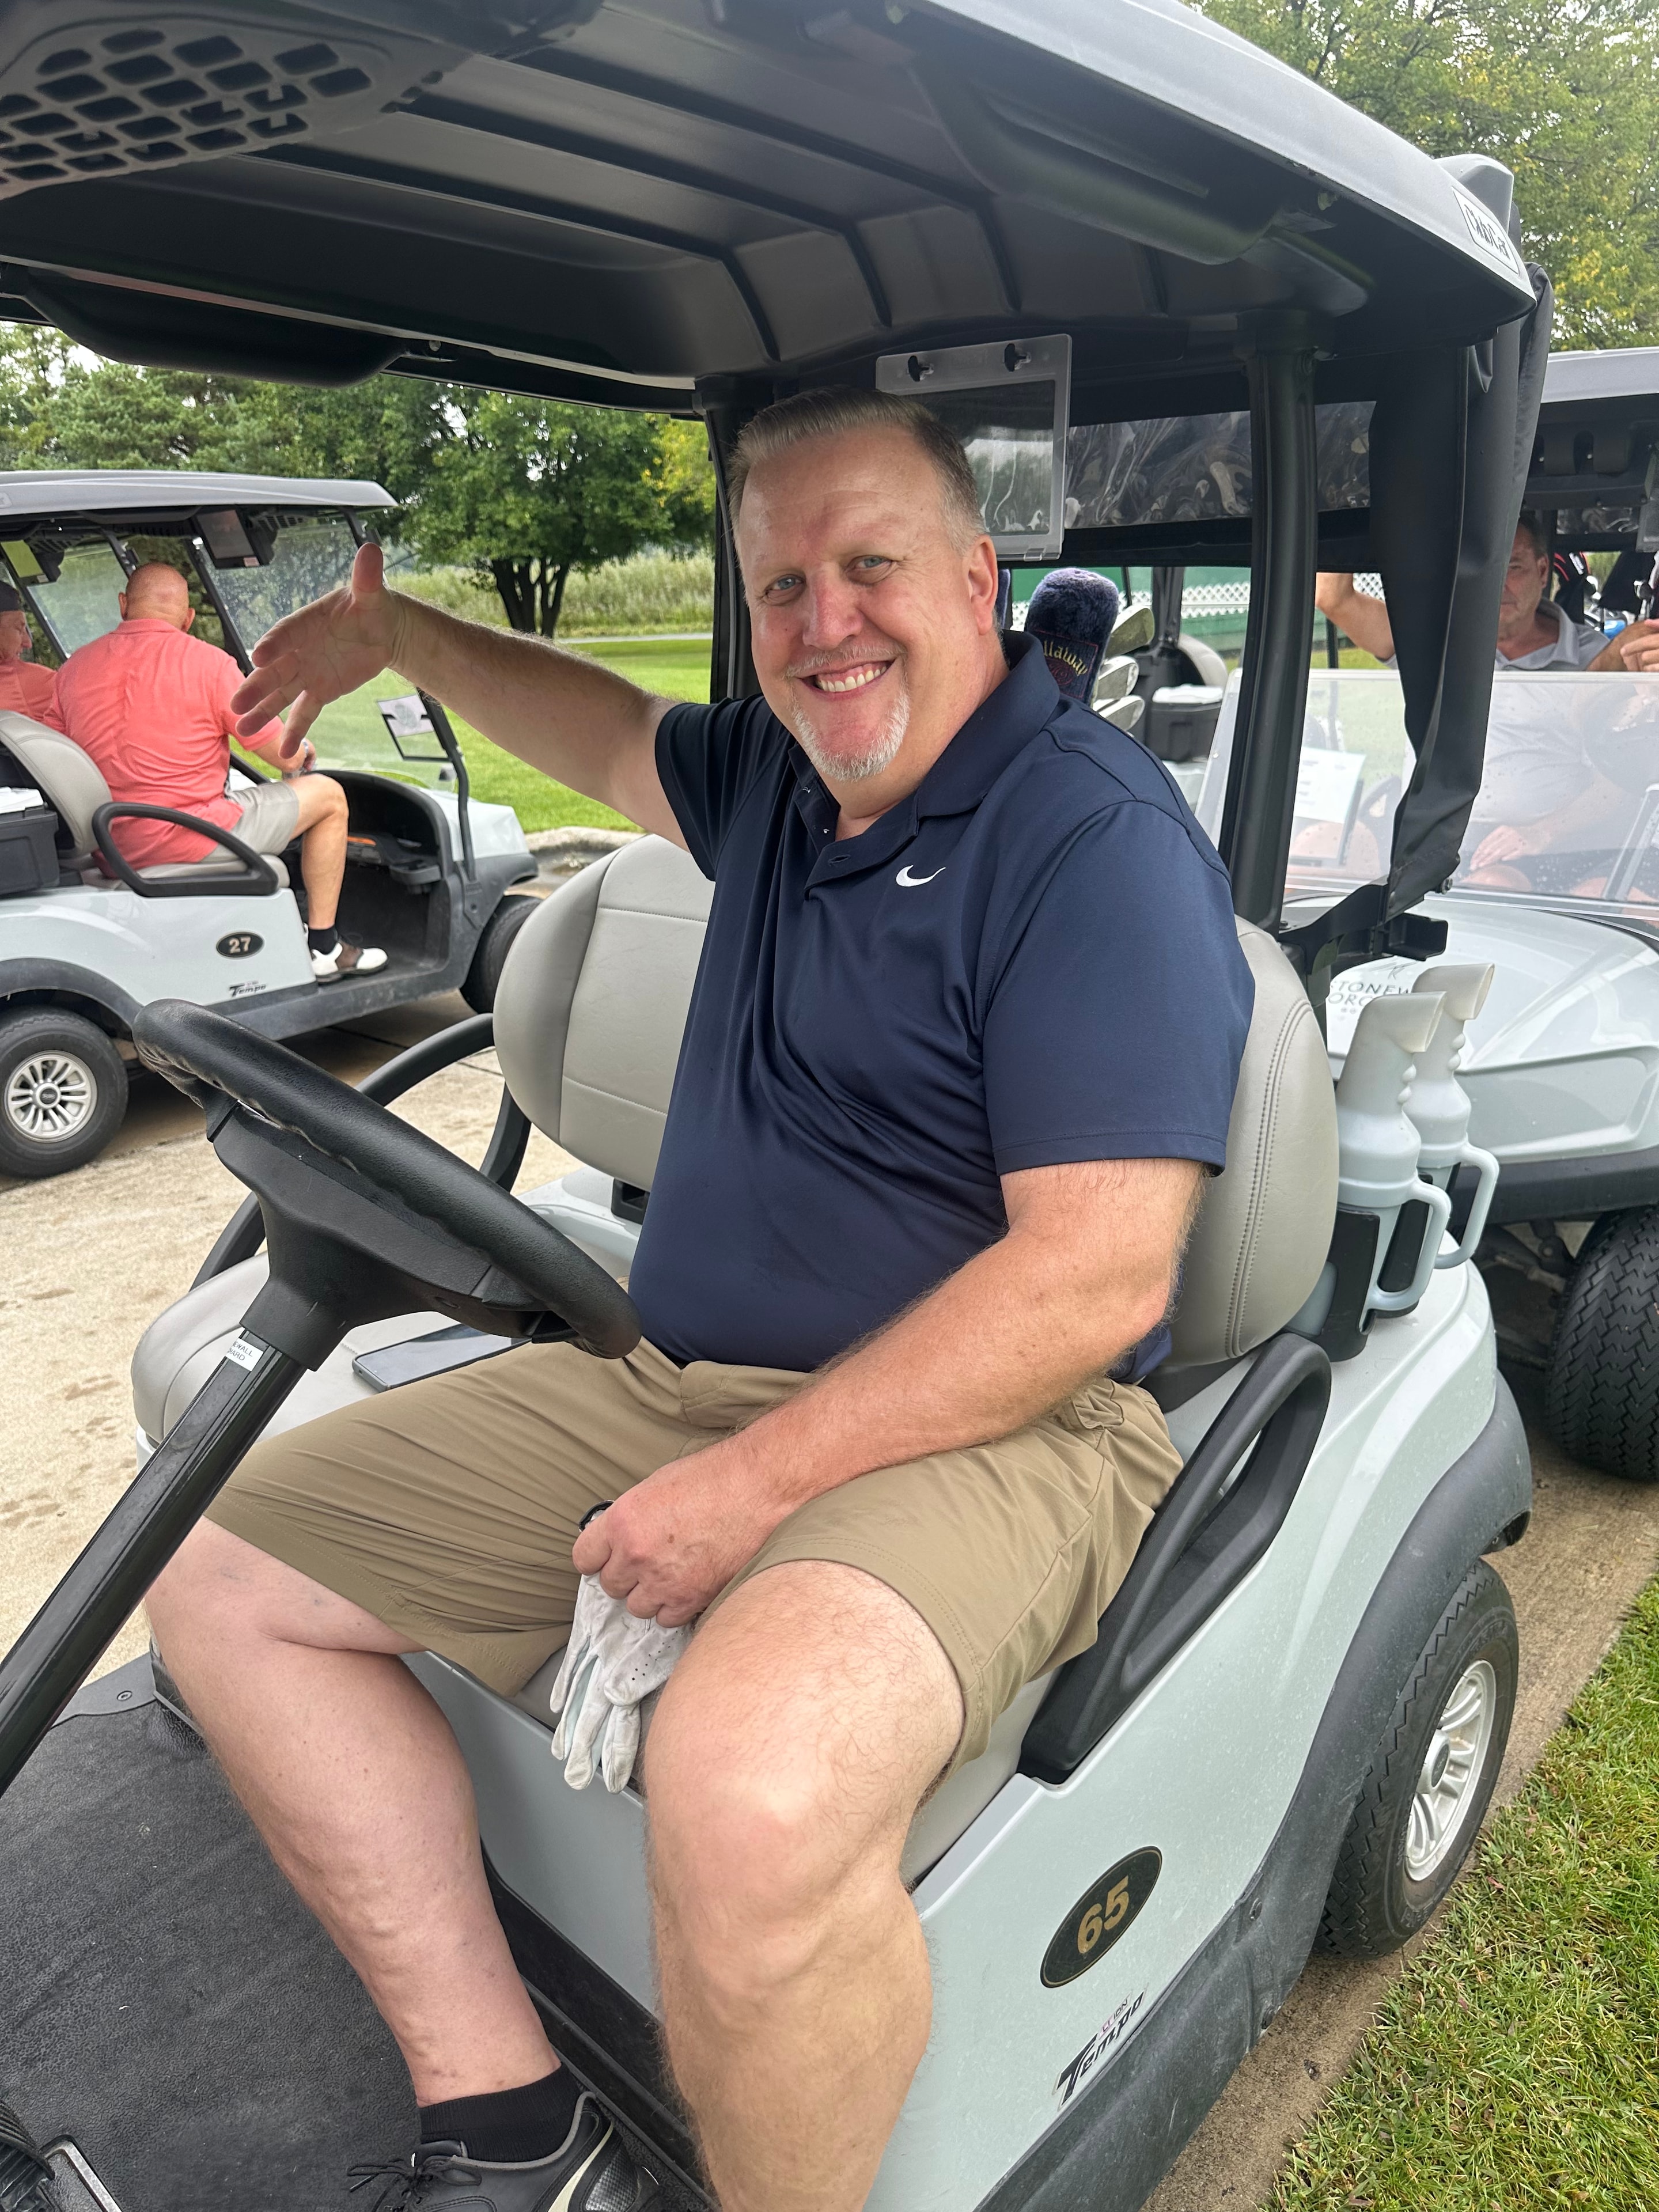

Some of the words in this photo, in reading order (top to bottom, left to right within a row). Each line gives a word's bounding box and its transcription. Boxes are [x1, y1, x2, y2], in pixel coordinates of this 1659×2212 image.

[229, 936, 251, 954] 27
[229, 983, 267, 998] Tempo
[1077, 1875, 1129, 1954] 65
[1056, 1991, 1145, 2106] Tempo
